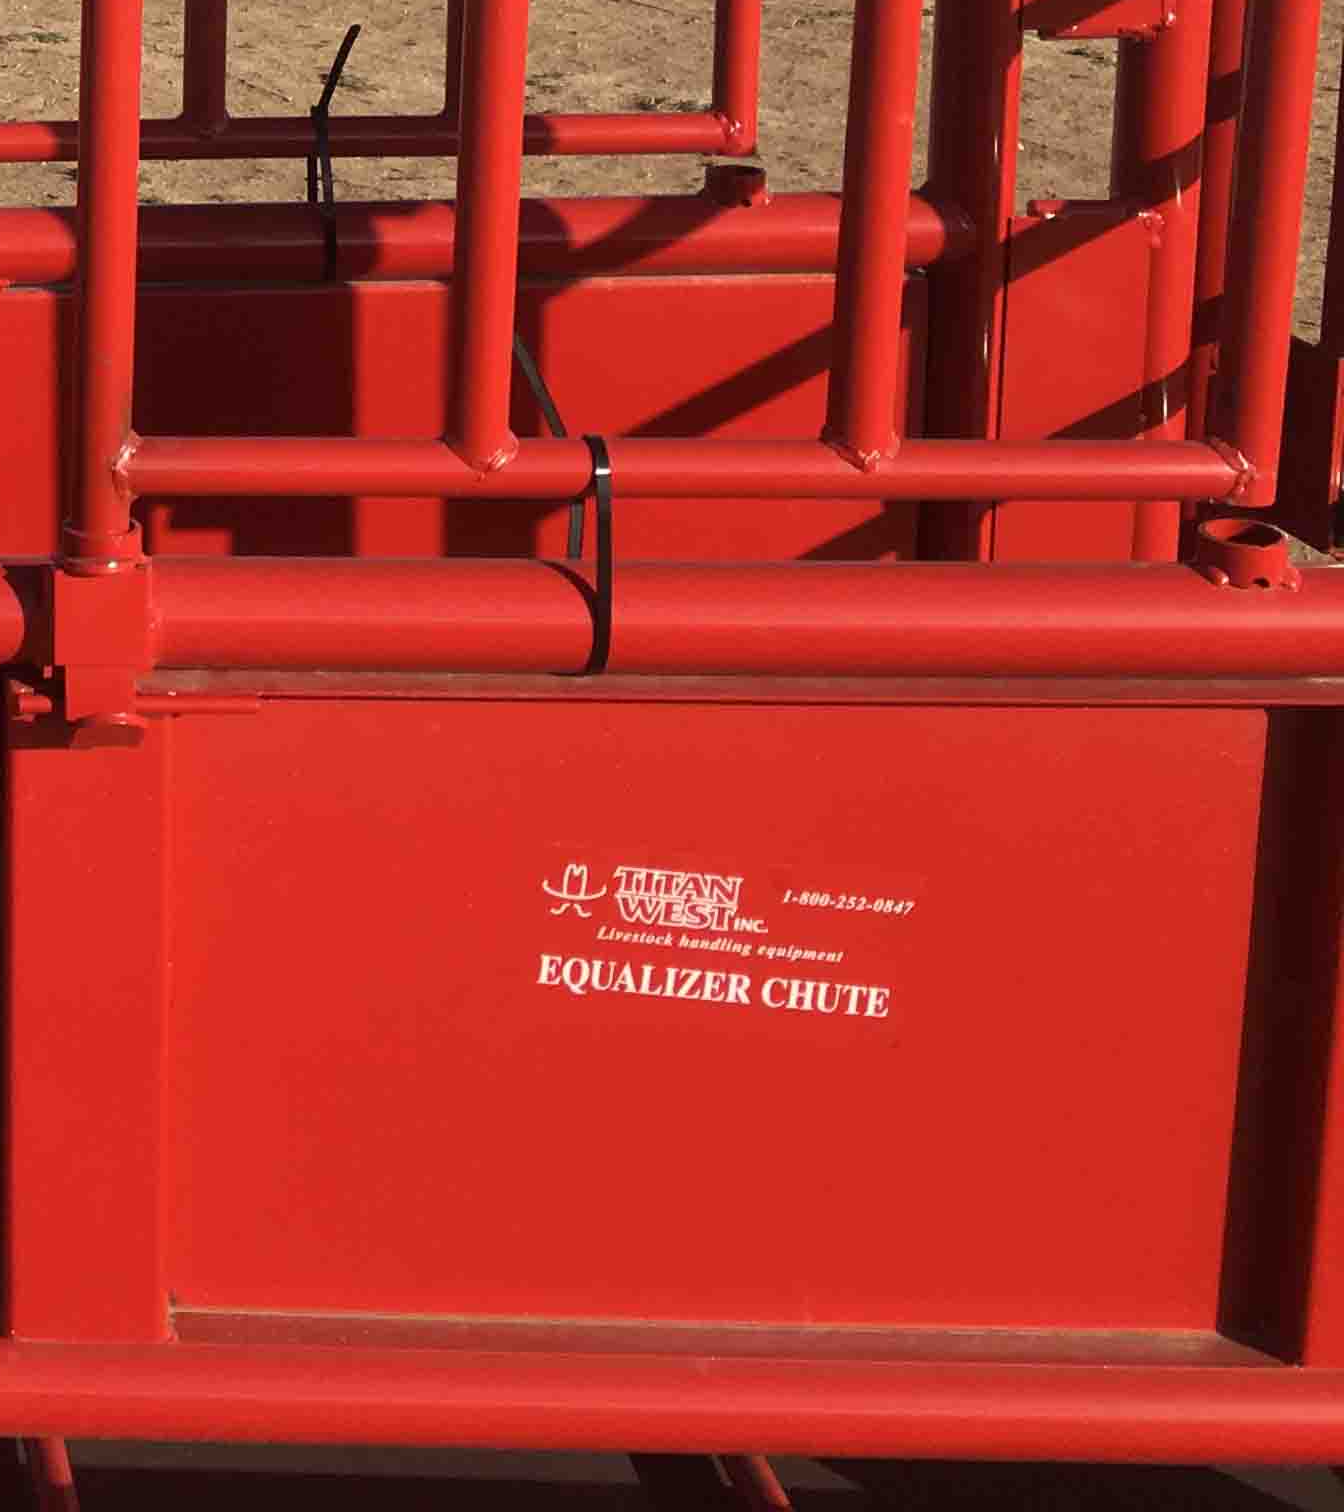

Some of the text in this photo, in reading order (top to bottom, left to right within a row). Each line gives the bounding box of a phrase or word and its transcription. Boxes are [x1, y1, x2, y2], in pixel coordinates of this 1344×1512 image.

[613, 866, 744, 907] TITAN
[783, 889, 914, 916] 1-800-252-0847
[616, 894, 769, 933] WEST INC.
[596, 925, 844, 964] Livestock handling equipment
[537, 953, 891, 1018] EQUALIZER CHUTE
